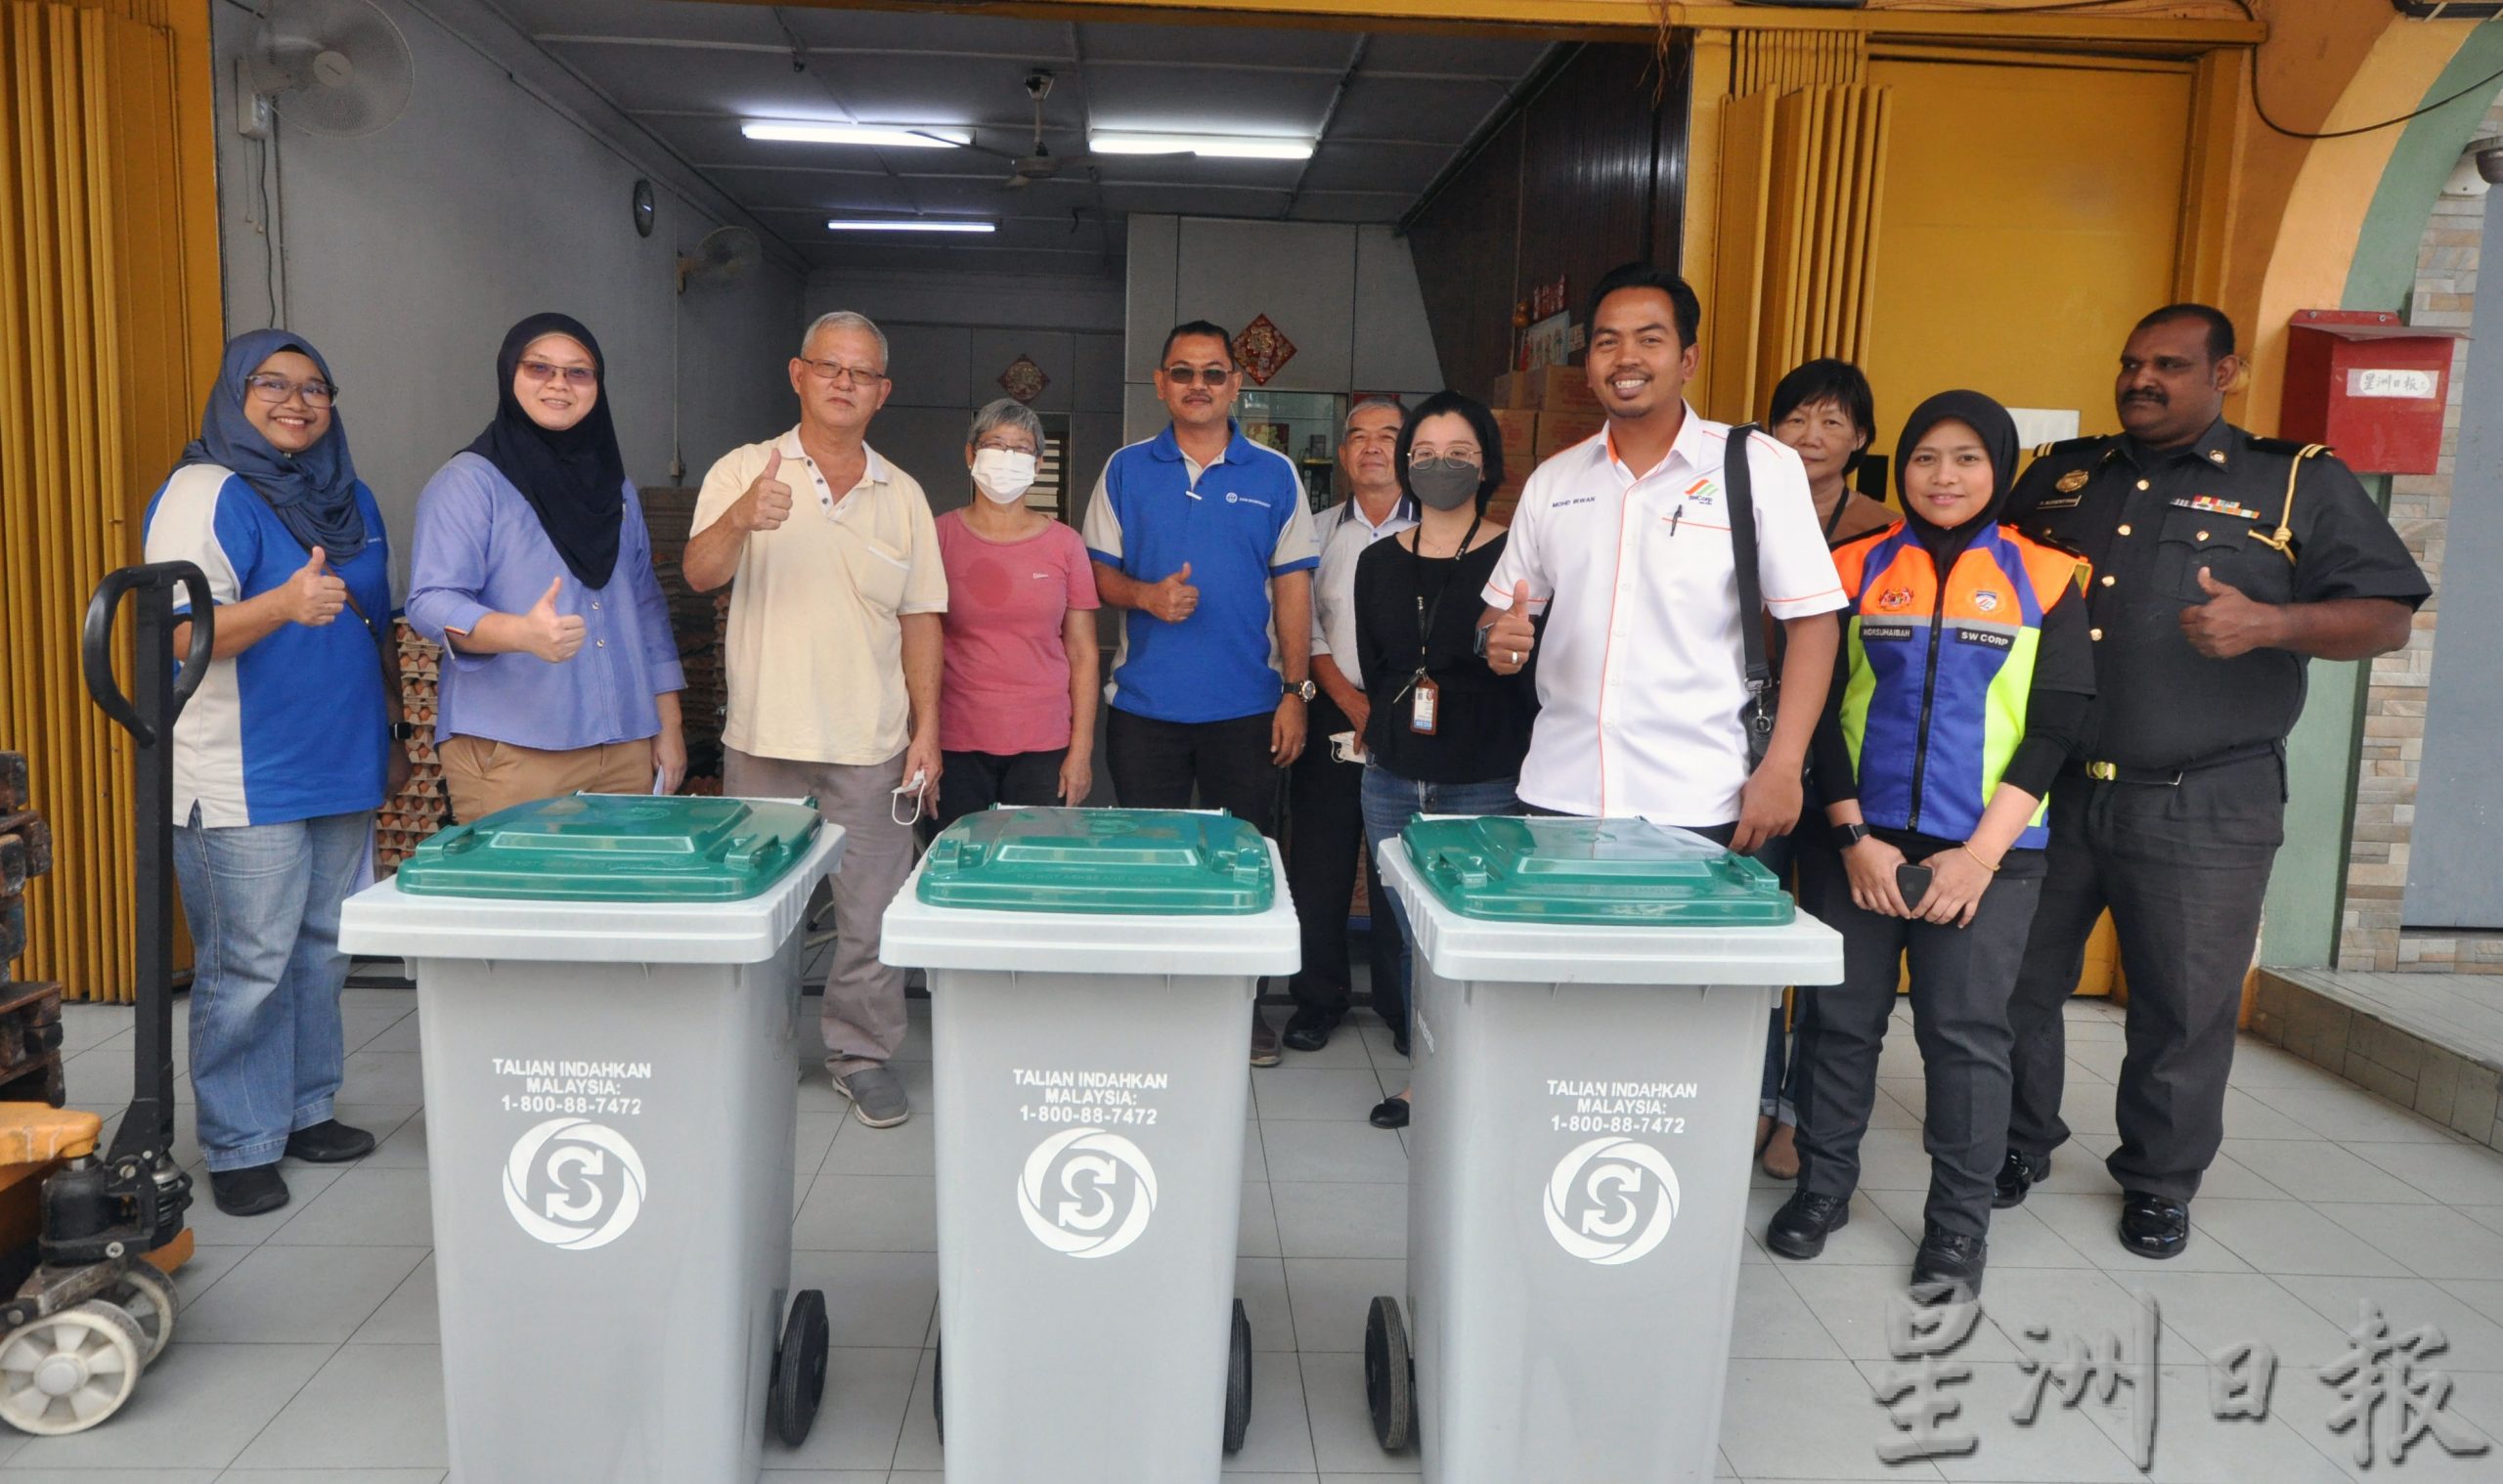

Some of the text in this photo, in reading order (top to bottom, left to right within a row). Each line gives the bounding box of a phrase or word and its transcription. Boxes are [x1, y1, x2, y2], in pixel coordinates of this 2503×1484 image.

[1960, 631, 2009, 647] SW CORP
[492, 1058, 651, 1078] TALIAN INDAHKAN
[526, 1077, 621, 1095] MALAYSIA:
[1012, 1069, 1167, 1089] TALIAN INDAHKAN
[1547, 1079, 1697, 1098] TALIAN INDAHKAN
[501, 1095, 642, 1114] 1-800-88-7472
[1045, 1088, 1137, 1105] MALAYSIA:
[1577, 1098, 1666, 1114] MALAYSIA:
[1019, 1105, 1158, 1125] 1-800-88-7472
[1551, 1114, 1686, 1134] 1-800-88-7472
